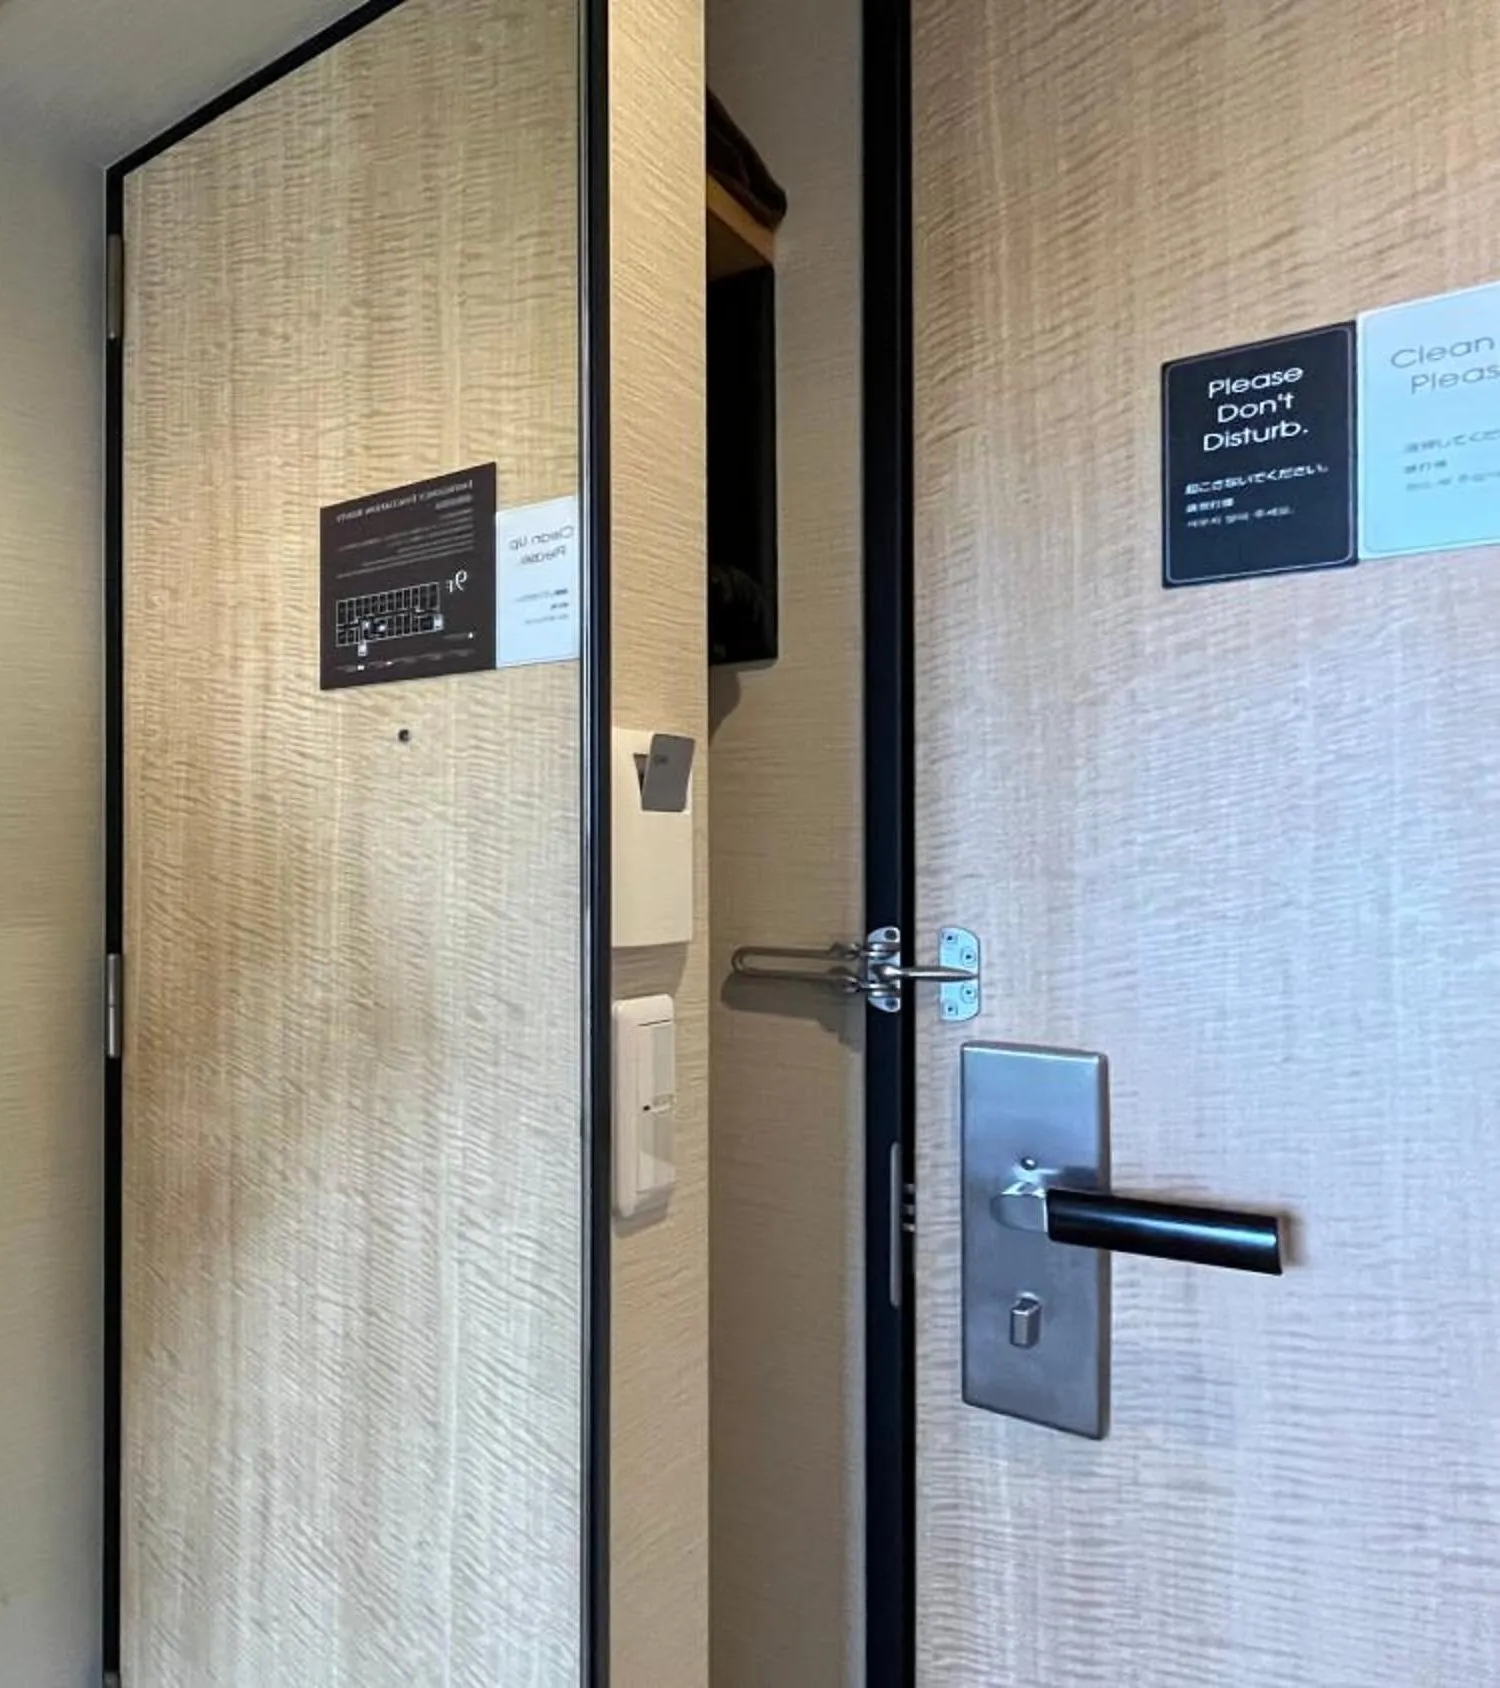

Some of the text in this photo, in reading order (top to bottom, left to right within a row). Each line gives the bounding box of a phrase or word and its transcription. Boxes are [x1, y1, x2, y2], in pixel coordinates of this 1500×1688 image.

[1390, 335, 1496, 369] Clean
[1208, 367, 1304, 399] Please
[1217, 392, 1295, 424] Don't
[1203, 419, 1309, 452] Disturb.
